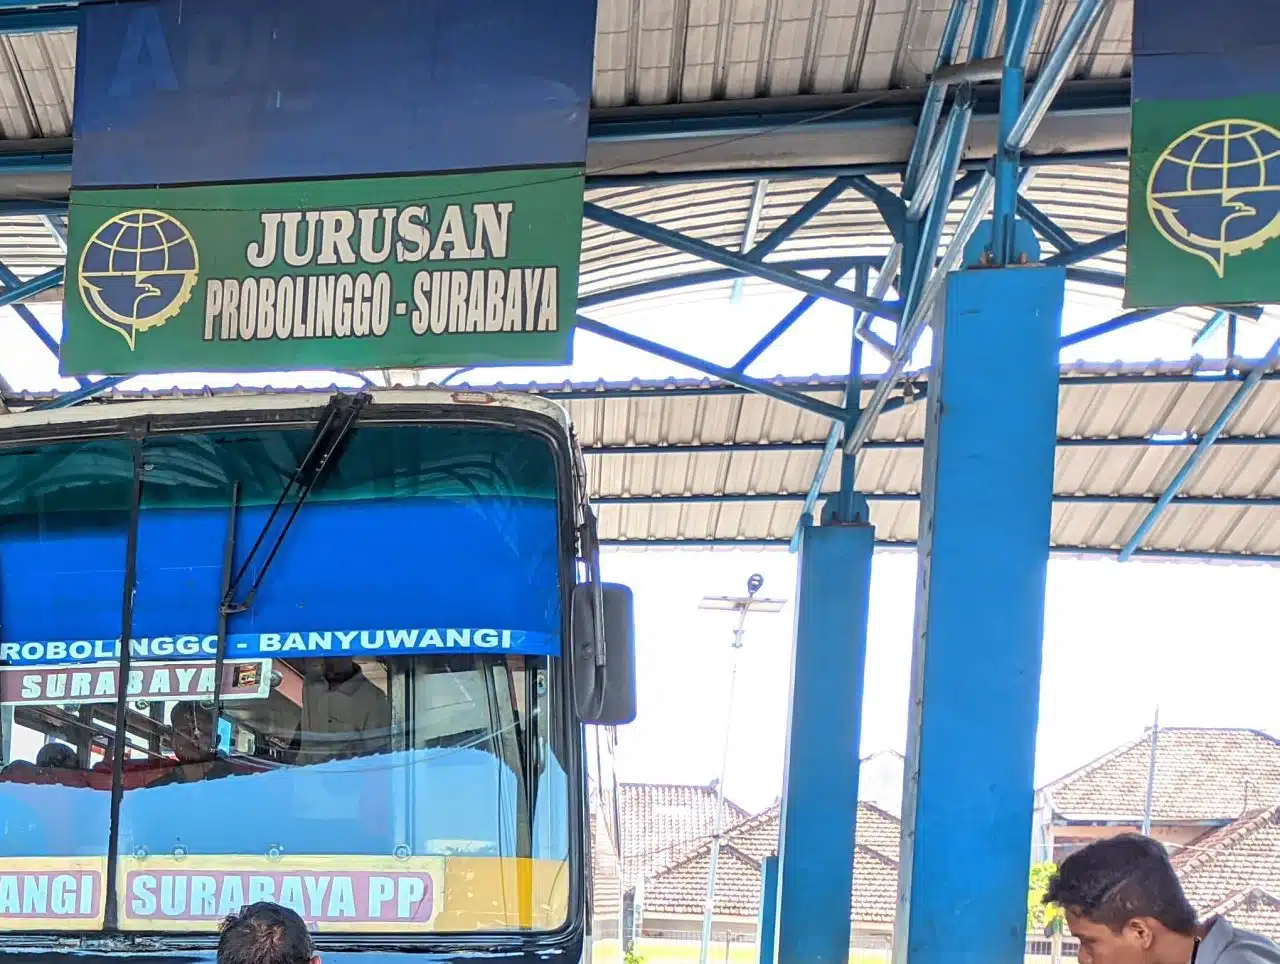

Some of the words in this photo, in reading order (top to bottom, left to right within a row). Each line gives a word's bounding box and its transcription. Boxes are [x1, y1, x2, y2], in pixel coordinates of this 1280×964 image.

[247, 202, 514, 268] JURUSAN
[203, 272, 391, 340] PROBOLINGGO
[411, 266, 559, 335] SURABAYA
[259, 628, 512, 652] BANYUWANGI
[21, 667, 215, 699] SURABAYA
[132, 874, 356, 917] SURABAYA
[368, 876, 425, 918] PP
